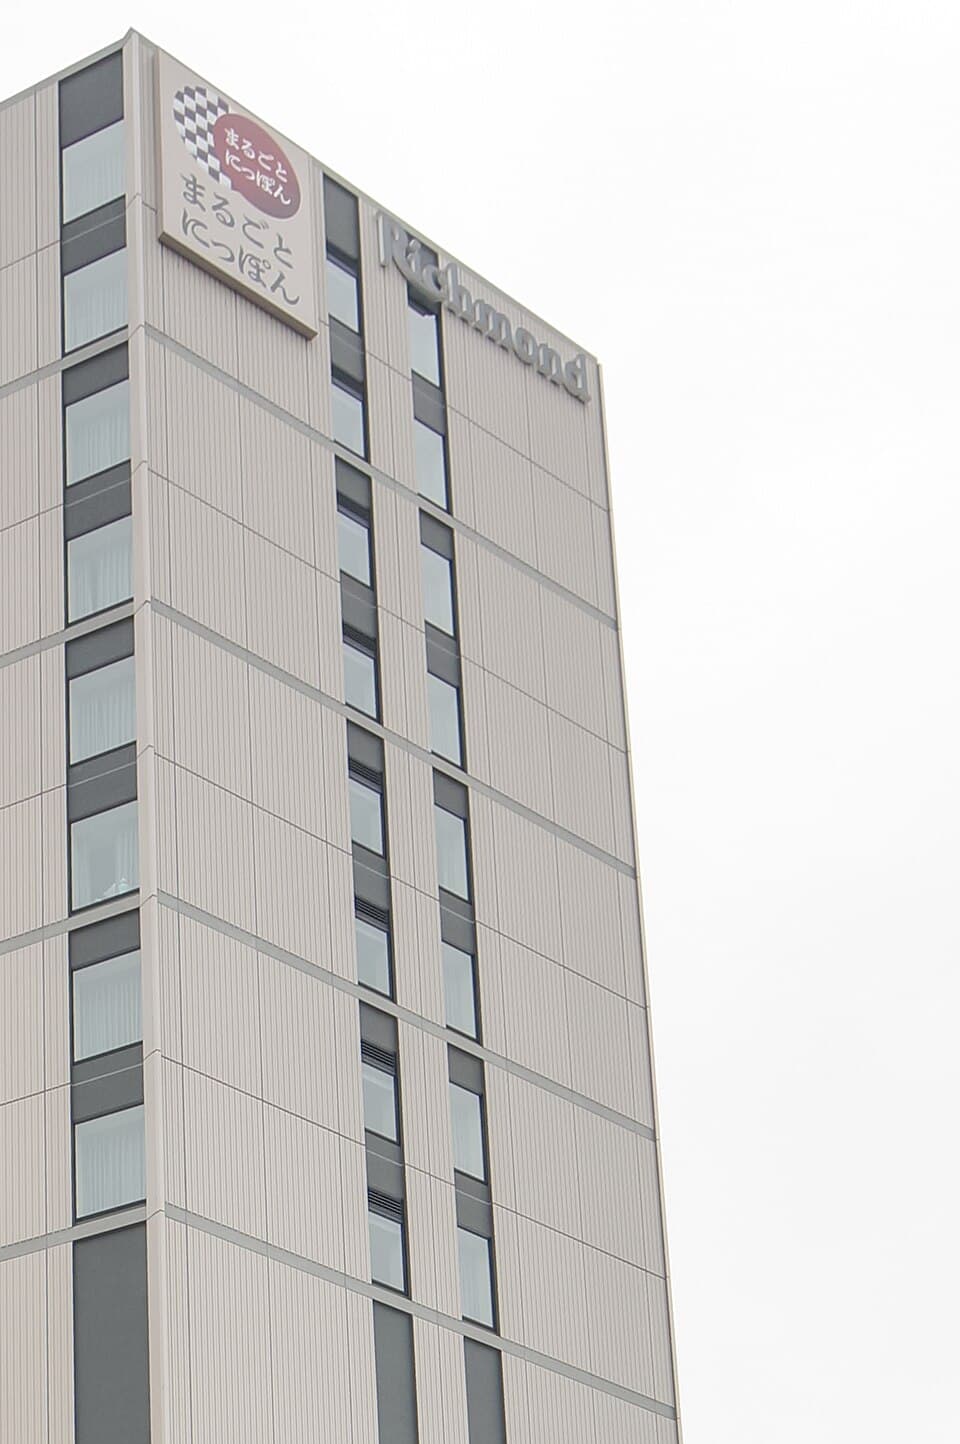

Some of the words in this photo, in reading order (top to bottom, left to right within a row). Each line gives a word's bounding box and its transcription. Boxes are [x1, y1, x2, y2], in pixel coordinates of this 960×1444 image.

[224, 127, 289, 183] まるごと
[224, 148, 292, 206] にっぽん
[180, 172, 294, 269] まるごと
[182, 207, 300, 306] にっぽん
[376, 208, 592, 405] Richmond
